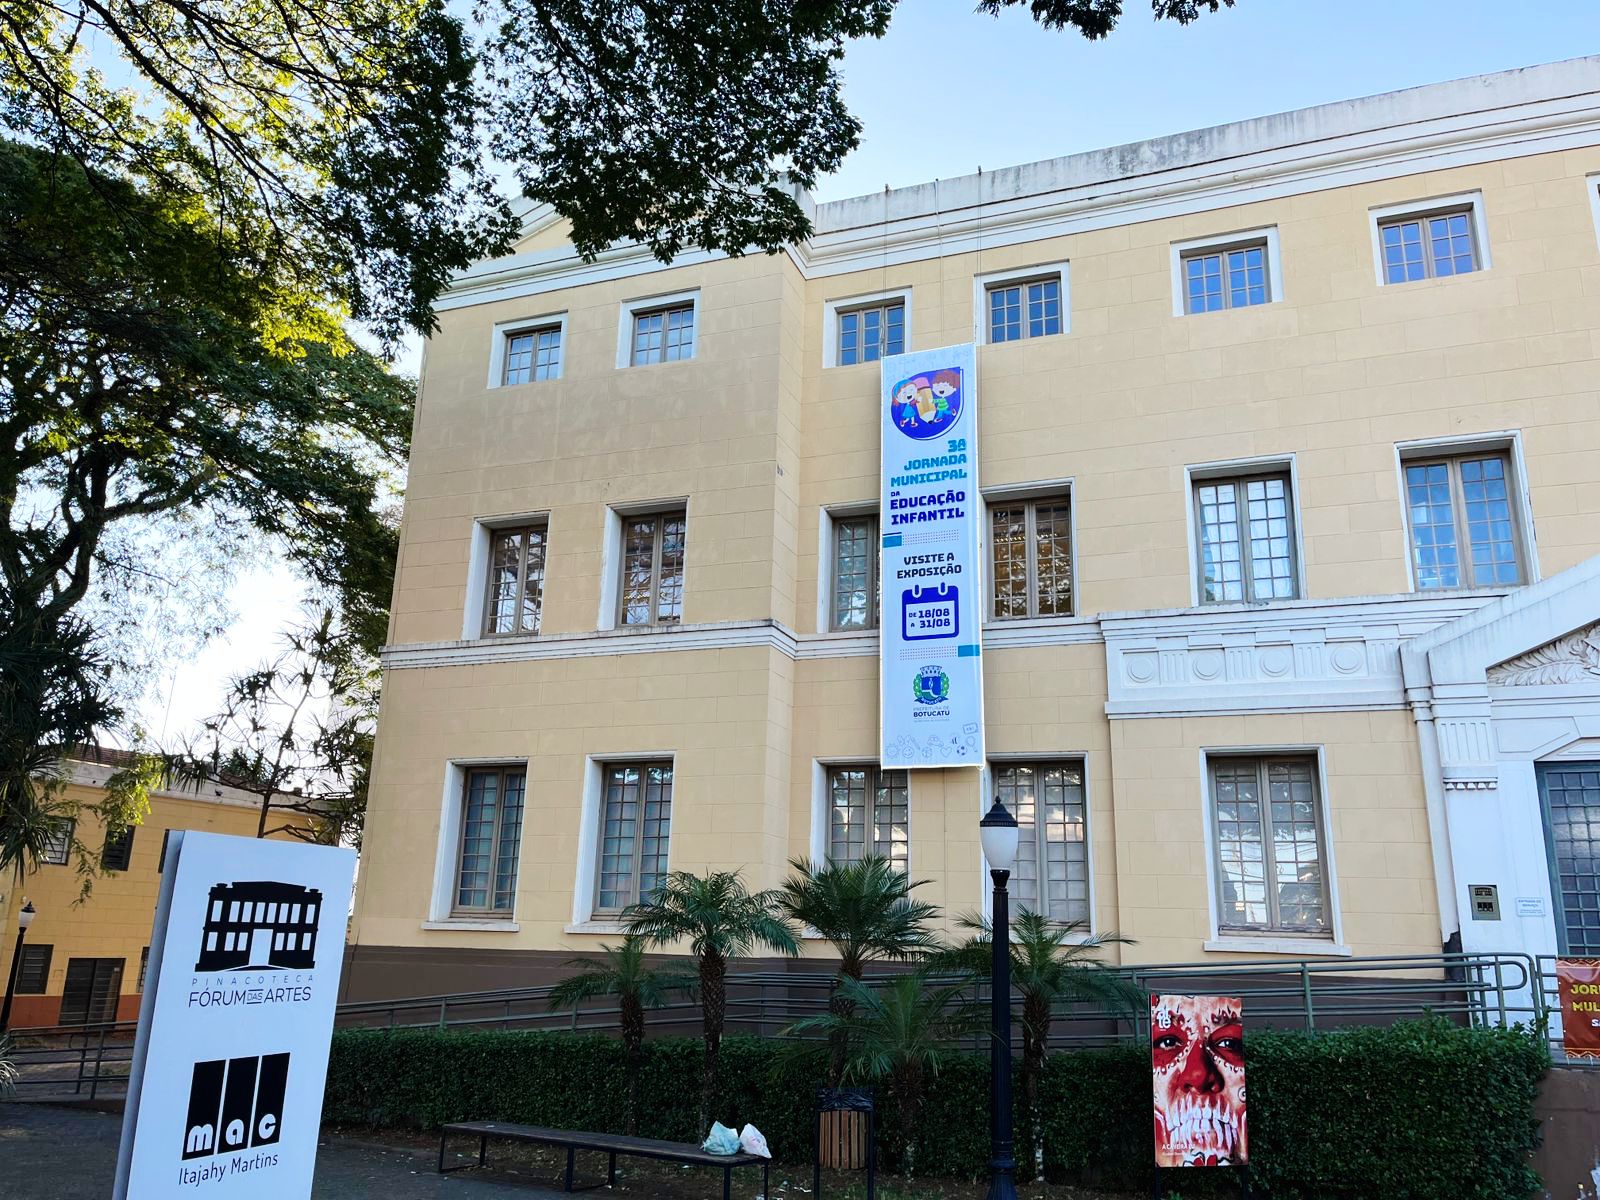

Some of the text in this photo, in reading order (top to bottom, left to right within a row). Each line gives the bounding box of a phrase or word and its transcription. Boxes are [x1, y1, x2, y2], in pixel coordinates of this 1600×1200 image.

[904, 453, 966, 471] JORNADA
[891, 468, 967, 487] MUNICIPAL
[890, 490, 965, 510] EDUCAÇÃO
[891, 507, 965, 525] INFANTIL
[904, 552, 955, 565] VISITE A
[897, 564, 962, 580] EXPOSIÇÃO
[918, 608, 950, 619] 18/08
[919, 618, 951, 629] 31/08
[913, 710, 950, 718] BOTUCATU
[192, 974, 313, 987] PINACOTECA
[188, 986, 312, 1008] FÓRUM DAS ARTES
[1591, 1018, 1600, 1027] S
[186, 1113, 277, 1153] mac
[178, 1153, 278, 1187] Itajahy Martins
